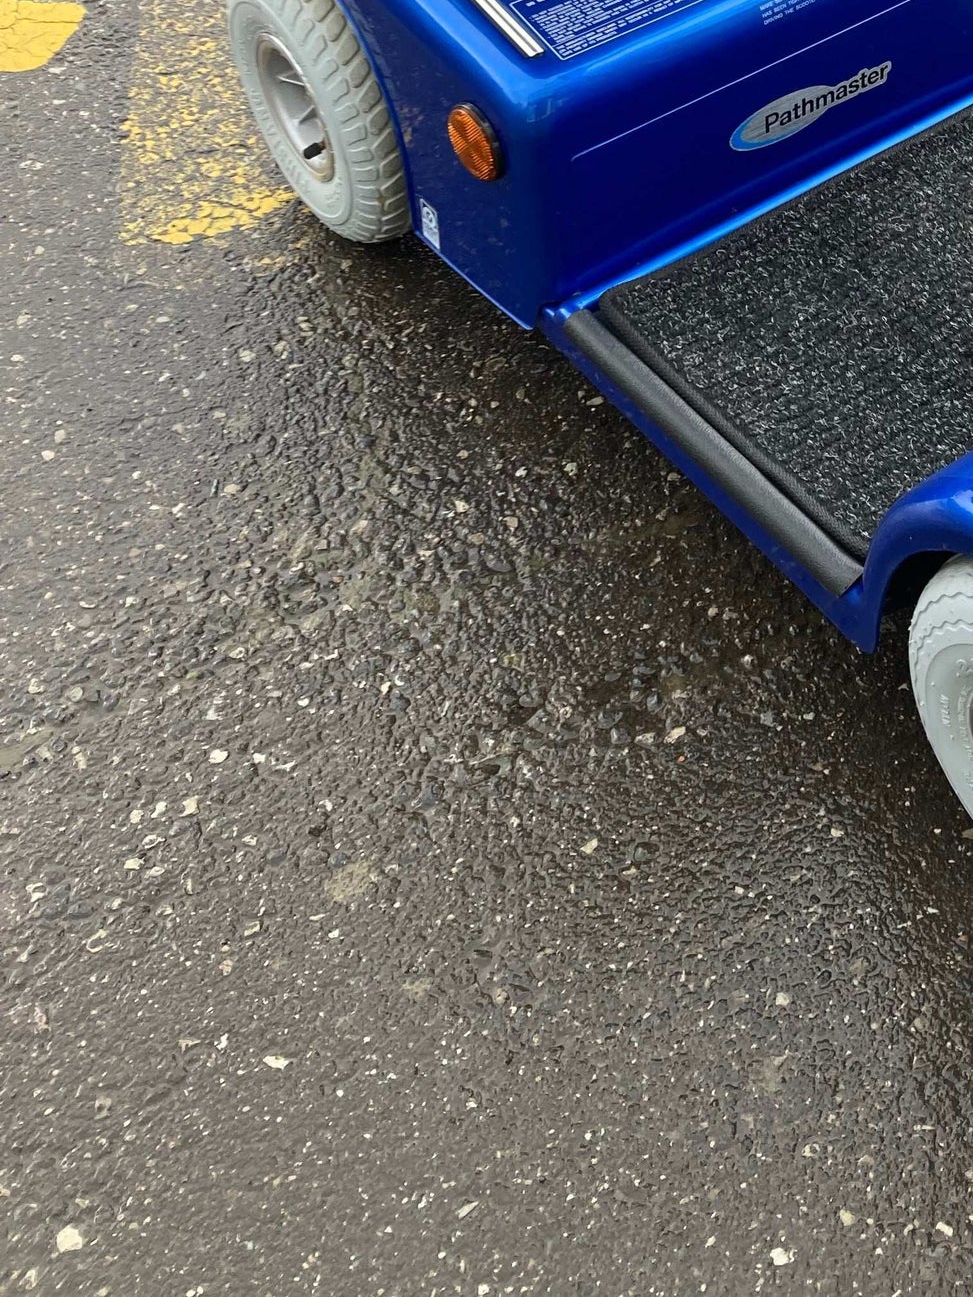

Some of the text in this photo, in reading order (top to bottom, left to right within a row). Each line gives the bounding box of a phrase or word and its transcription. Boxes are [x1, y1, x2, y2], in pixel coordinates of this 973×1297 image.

[762, 10, 772, 18] HAS
[774, 4, 787, 13] BEEN
[765, 64, 888, 134] Pathmaster
